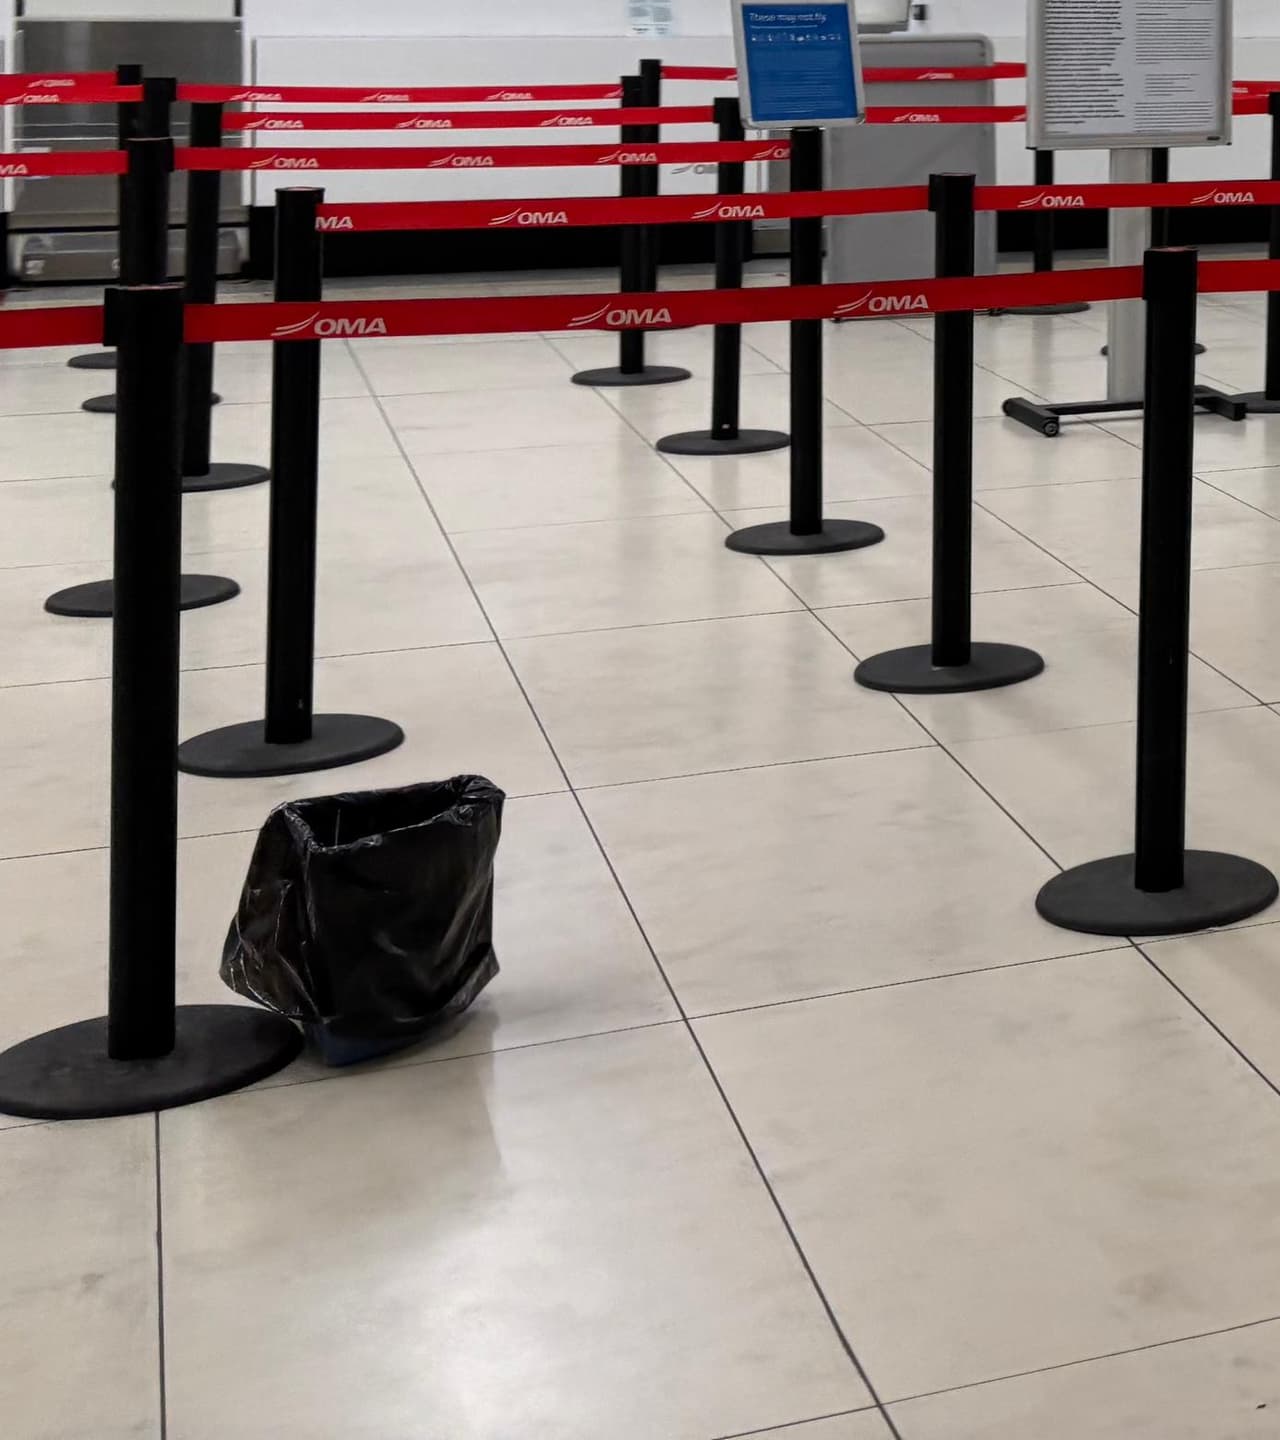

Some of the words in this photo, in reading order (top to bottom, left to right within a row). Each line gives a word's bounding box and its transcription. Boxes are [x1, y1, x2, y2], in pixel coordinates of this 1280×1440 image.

[265, 119, 304, 129] OMA
[415, 119, 452, 128] OMA
[558, 116, 593, 126] OMA
[274, 157, 319, 168] OMA
[452, 155, 494, 166] OMA
[617, 152, 657, 163] OMA
[0, 164, 28, 175] MA
[1041, 195, 1085, 207] OMA
[1213, 192, 1254, 204] OMA
[718, 204, 765, 218] OMA
[315, 216, 353, 229] MA
[517, 212, 568, 224] OMA
[867, 293, 929, 312] OMA
[605, 308, 672, 326] OMA
[313, 317, 388, 336] OMA
